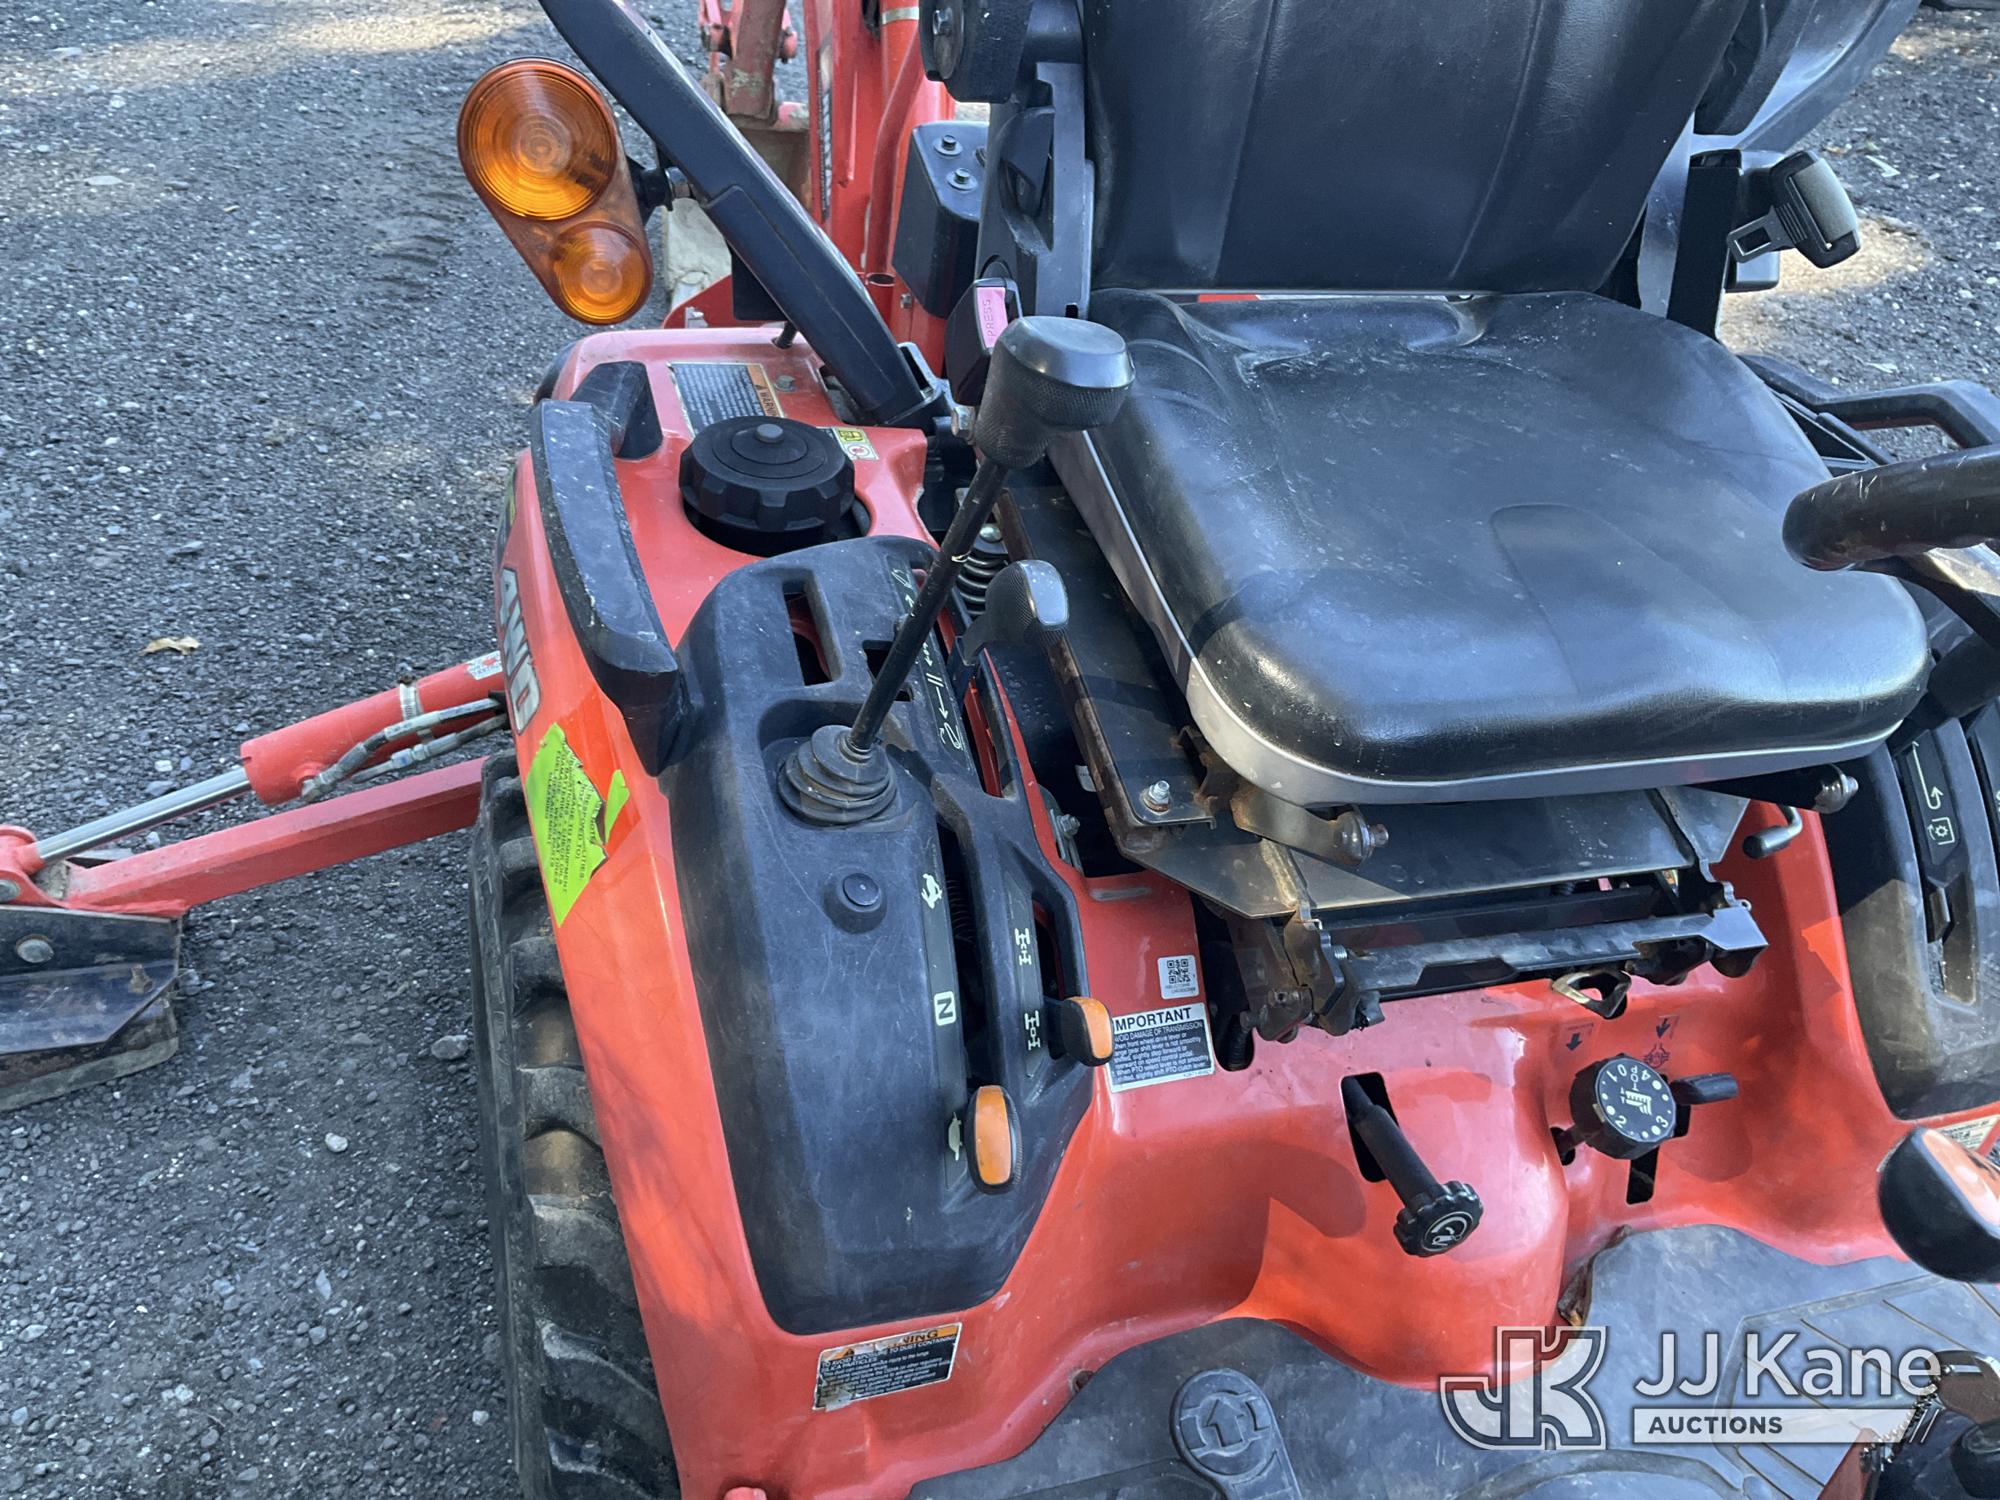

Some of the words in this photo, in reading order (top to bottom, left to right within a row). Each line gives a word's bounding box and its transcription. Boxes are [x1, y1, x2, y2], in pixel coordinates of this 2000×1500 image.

[983, 300, 997, 337] PRESS
[1115, 1007, 1192, 1031] MPORTANT
[1129, 1029, 1153, 1039] DAMAGE
[1153, 1027, 1162, 1035] OF
[1162, 1020, 1202, 1032] TRANSMISSION
[1641, 1069, 1651, 1081] 4
[1615, 1115, 1627, 1128] 2
[1656, 1115, 1669, 1128] 3
